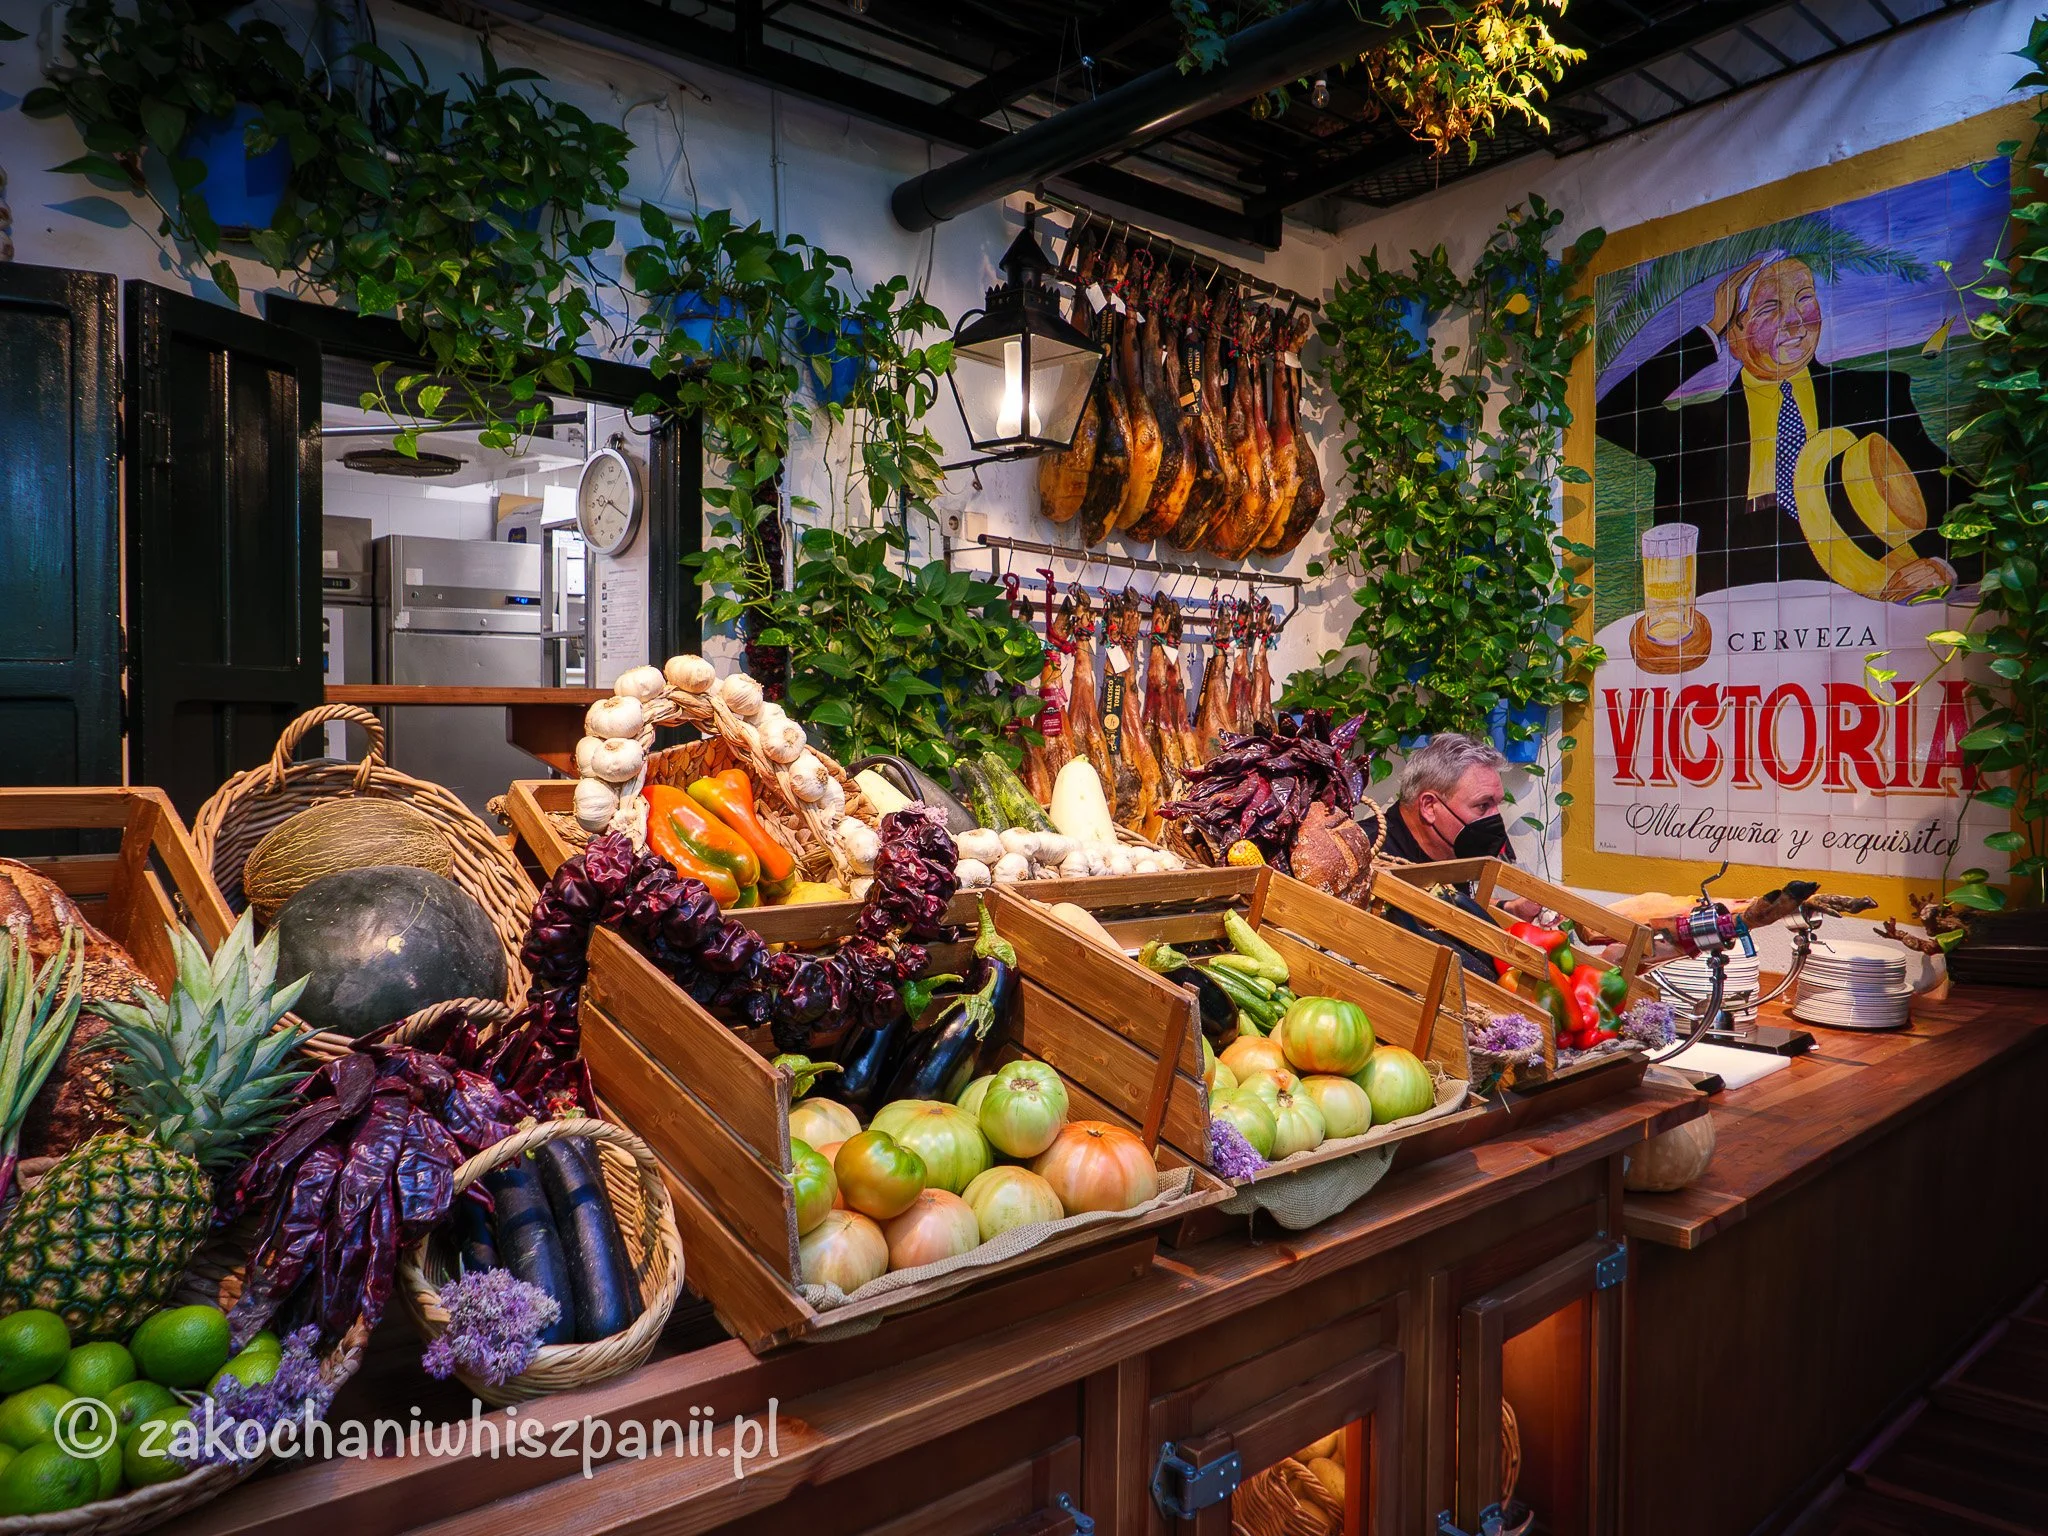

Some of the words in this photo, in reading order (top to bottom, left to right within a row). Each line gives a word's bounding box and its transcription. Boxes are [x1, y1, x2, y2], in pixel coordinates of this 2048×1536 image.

[1727, 626, 1878, 653] CERVEZA
[1106, 679, 1114, 713] FRANCISCO
[1113, 684, 1121, 708] TORRES
[1602, 681, 1990, 797] VICTORIA
[1625, 802, 1783, 854] Malagueña
[1791, 827, 1813, 860] y
[1822, 818, 1961, 865] exquisita
